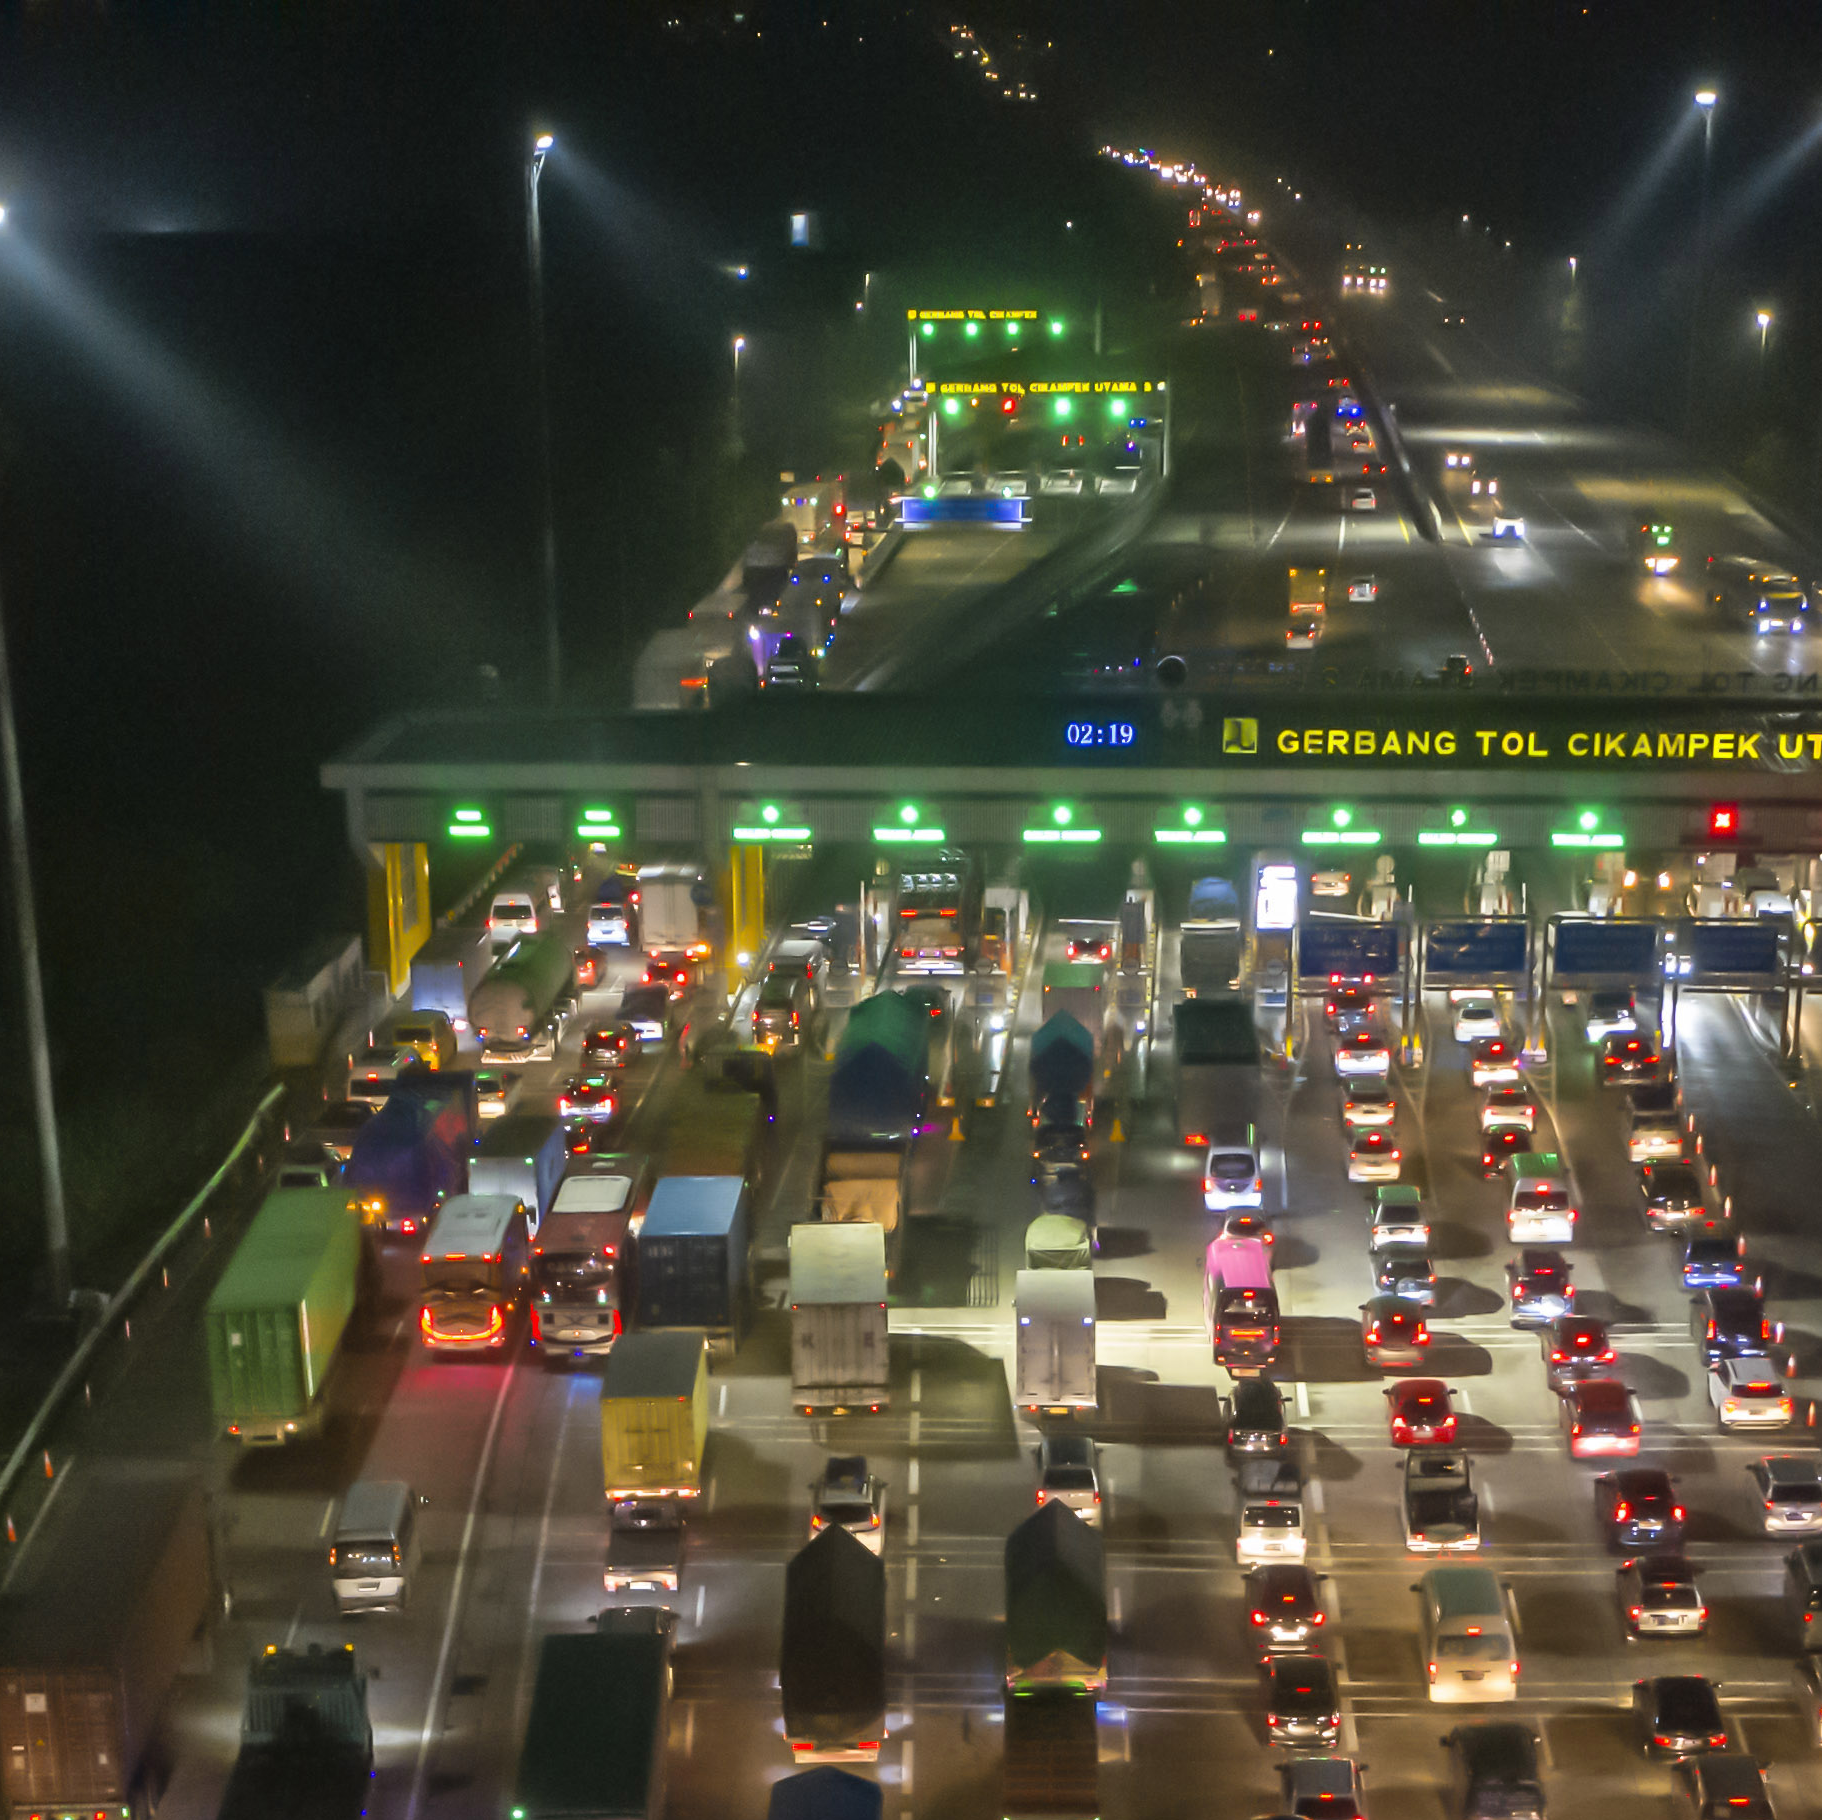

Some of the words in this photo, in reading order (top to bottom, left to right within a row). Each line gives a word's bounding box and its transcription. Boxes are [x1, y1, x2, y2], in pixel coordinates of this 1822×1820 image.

[1066, 723, 1134, 745] 02:19
[1277, 730, 1457, 755] GERBANG
[1476, 731, 1549, 756] TOL
[1567, 732, 1761, 759] CIKAMPEK
